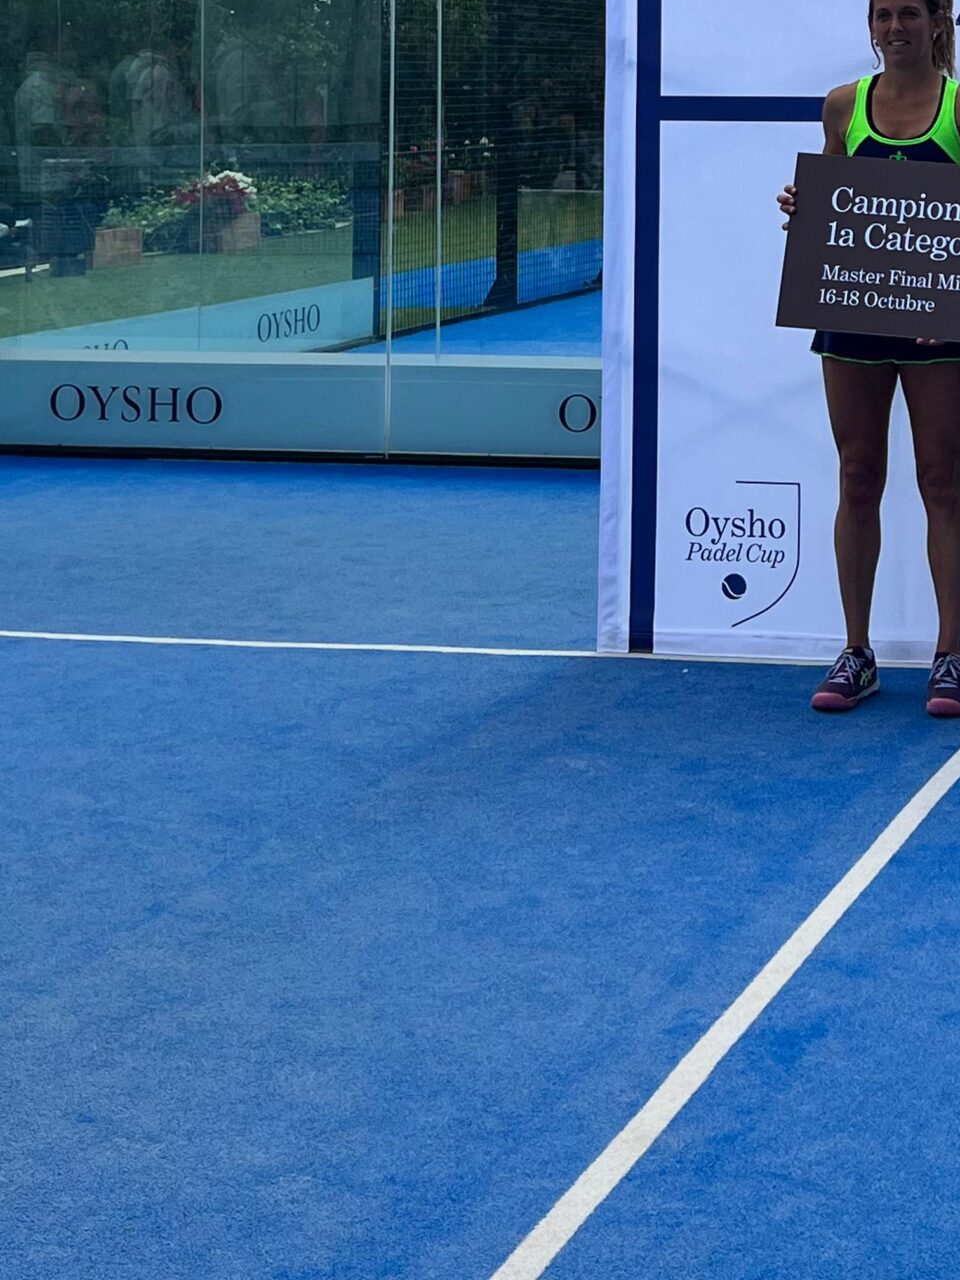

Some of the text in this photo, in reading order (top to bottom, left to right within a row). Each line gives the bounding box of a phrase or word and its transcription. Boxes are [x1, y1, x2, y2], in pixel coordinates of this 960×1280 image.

[821, 264, 885, 285] Master
[888, 269, 933, 289] Final
[818, 287, 935, 313] 16-18 Octubre
[257, 304, 321, 344] OYSHO
[49, 383, 223, 425] OYSHO
[685, 506, 786, 545] Oysho
[685, 541, 786, 569] Padel Cup
